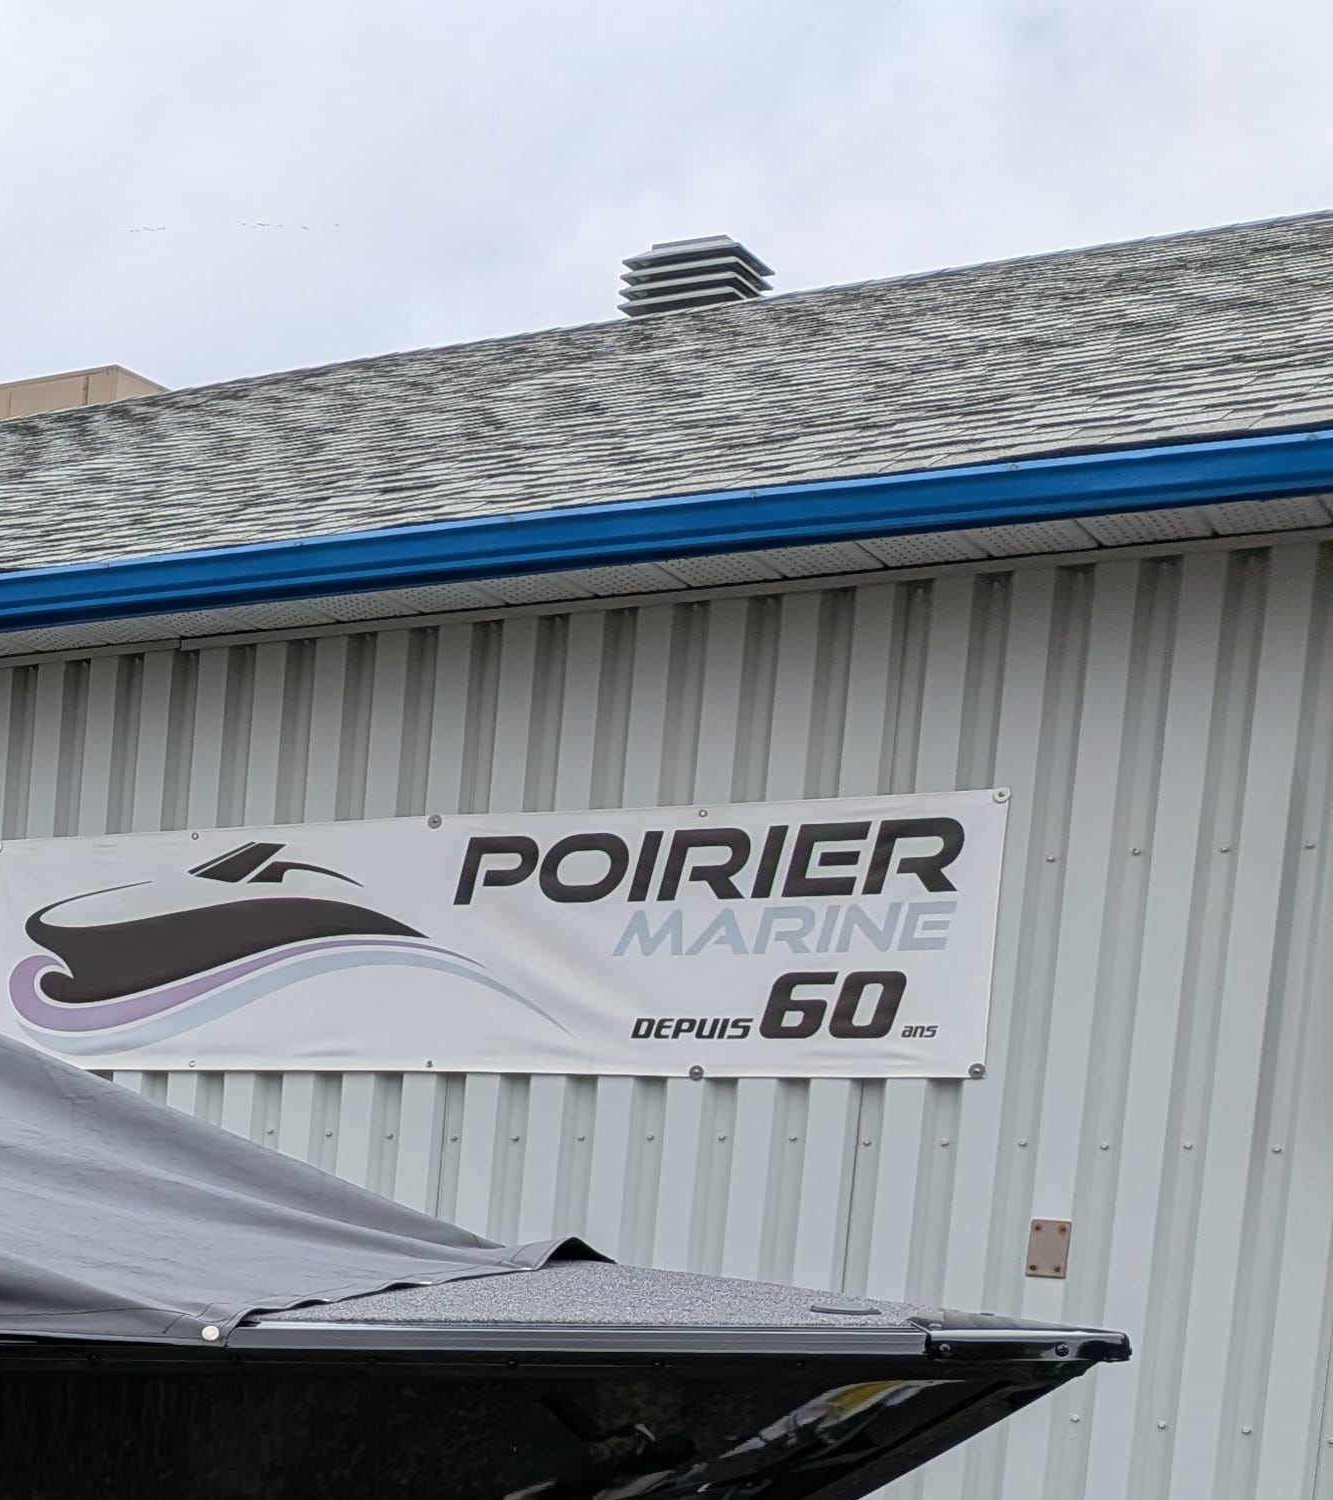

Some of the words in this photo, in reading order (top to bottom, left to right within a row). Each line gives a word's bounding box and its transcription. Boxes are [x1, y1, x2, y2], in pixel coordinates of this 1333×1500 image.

[453, 816, 965, 905] POIRIER
[612, 900, 958, 957] MARINE
[630, 1017, 754, 1039] DEPUIS
[759, 970, 908, 1039] 60
[900, 1025, 939, 1039] ans
